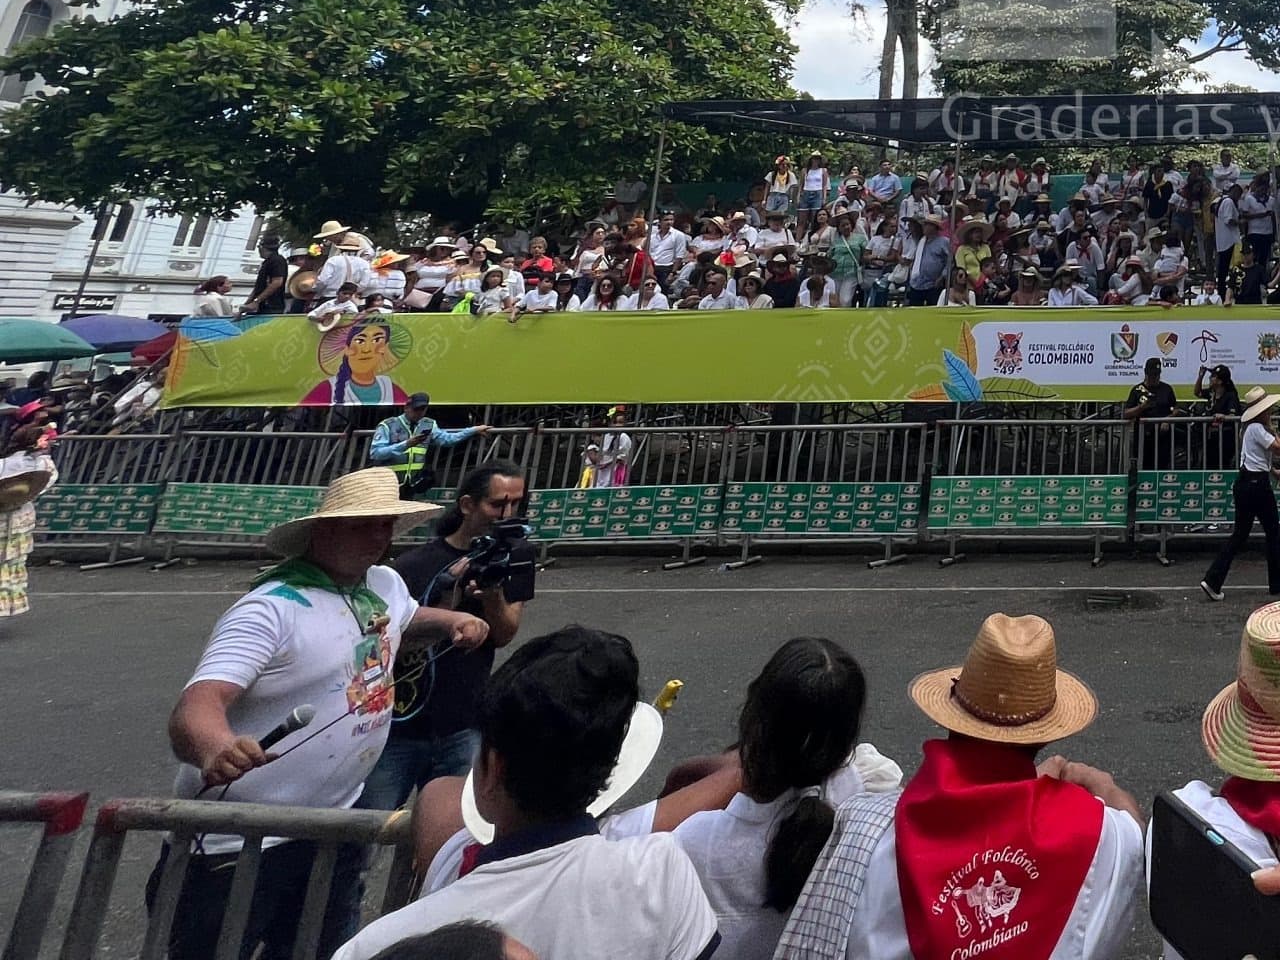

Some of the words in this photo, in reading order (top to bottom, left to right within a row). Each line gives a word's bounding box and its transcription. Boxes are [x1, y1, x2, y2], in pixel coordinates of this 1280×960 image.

[1028, 343, 1057, 351] FESTIVAL
[1028, 352, 1094, 365] COLOMBIANO
[931, 853, 979, 915] Festival
[982, 846, 1040, 880] Folclórico
[950, 920, 1029, 960] Colombiano
